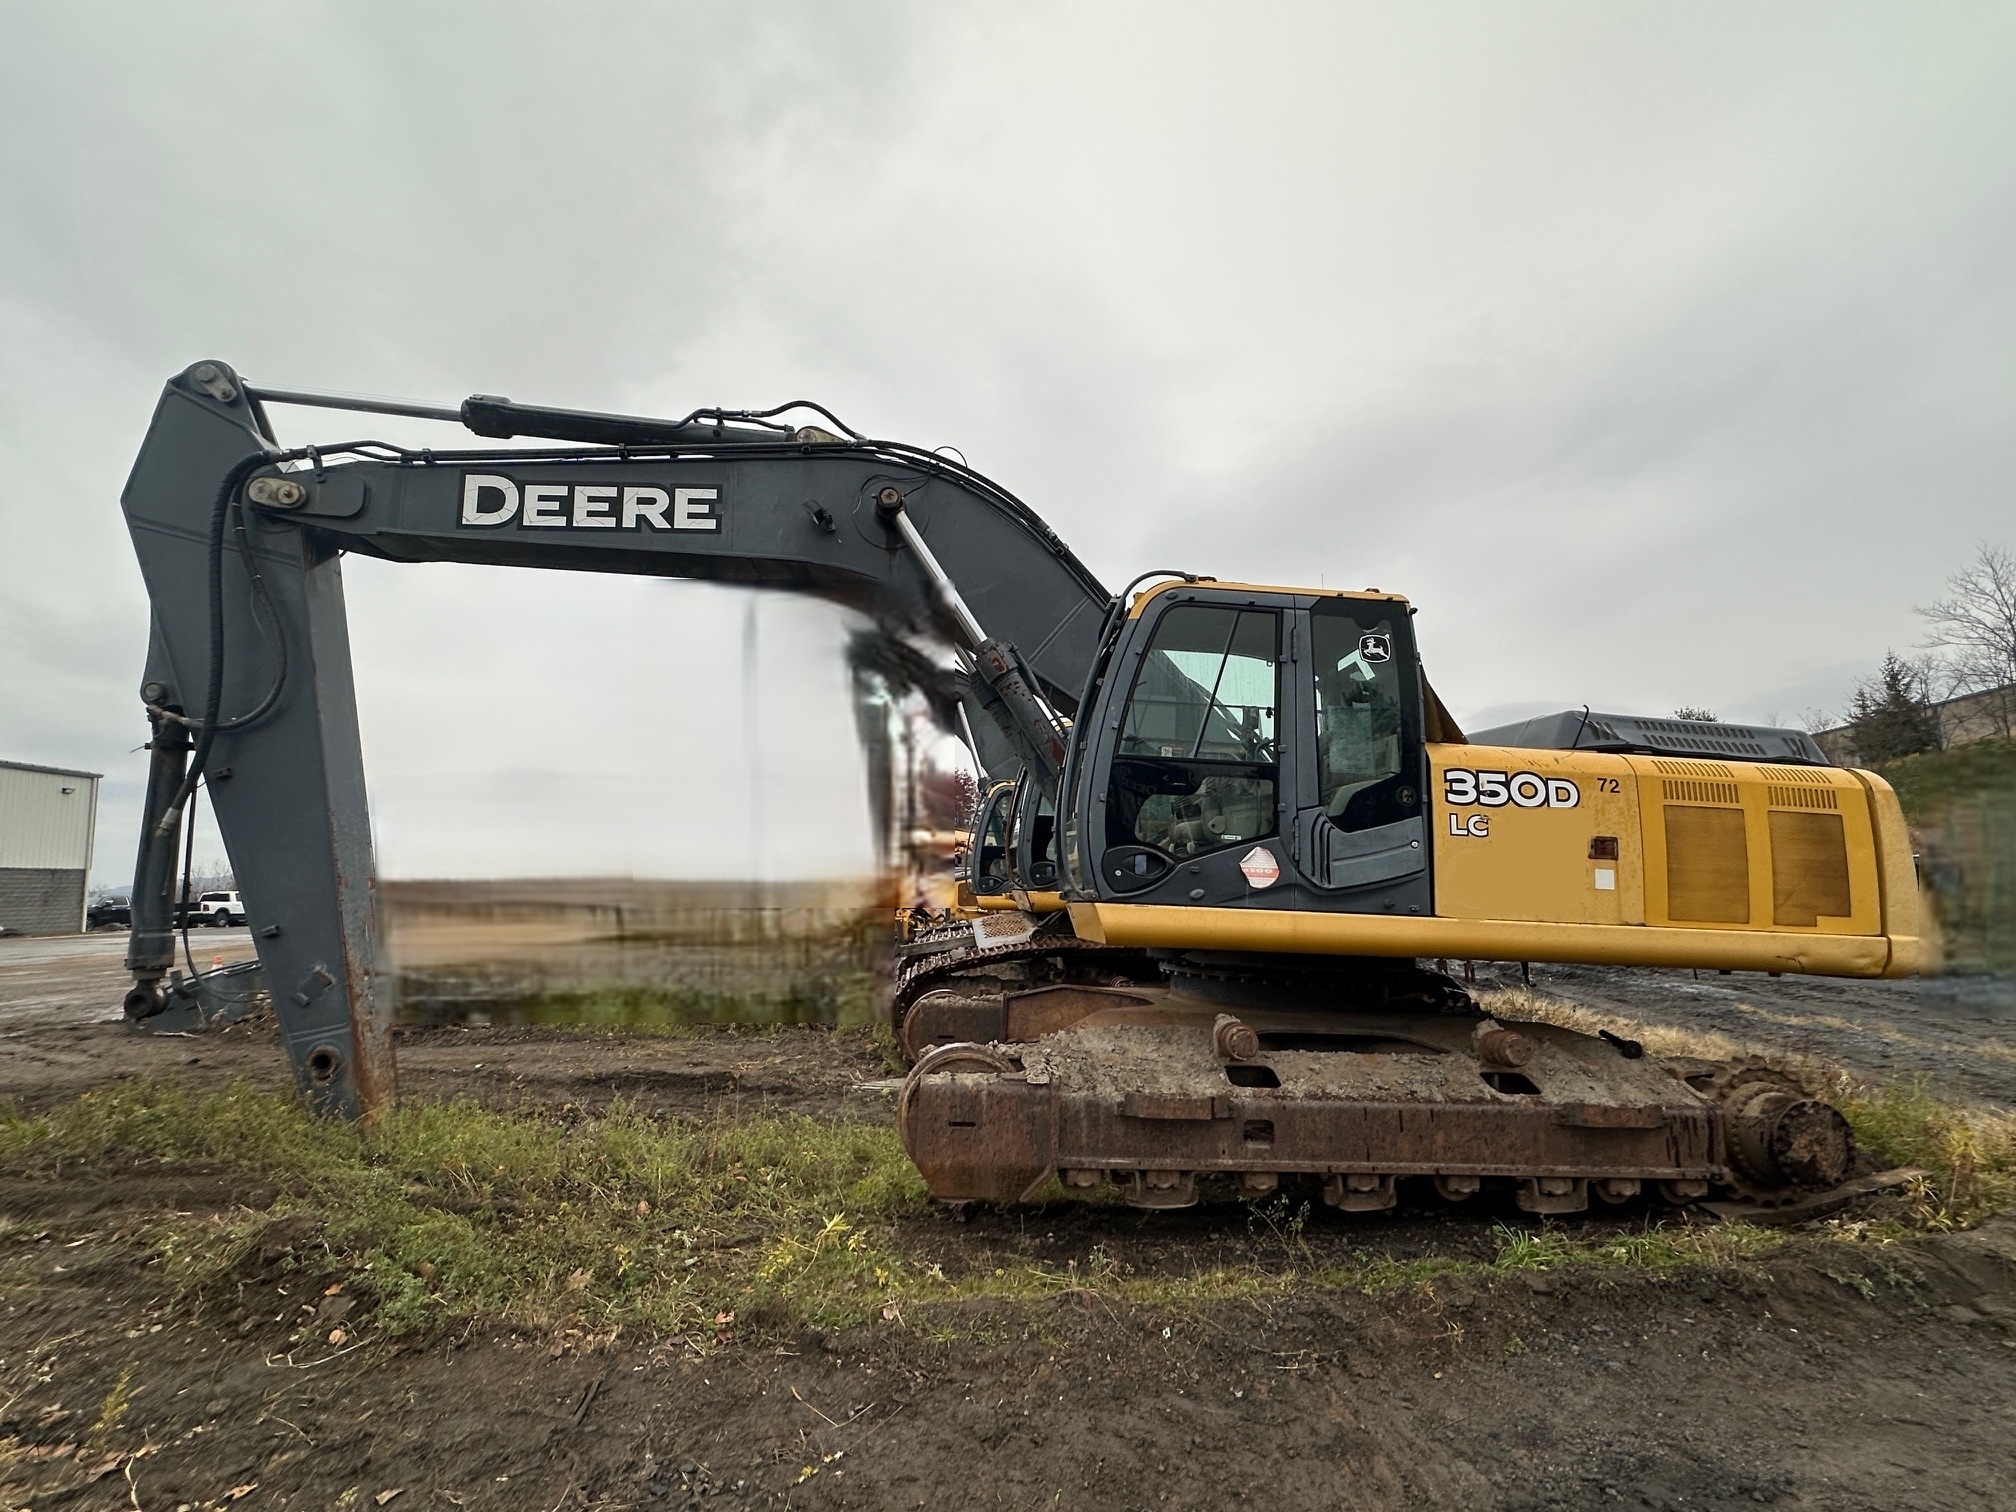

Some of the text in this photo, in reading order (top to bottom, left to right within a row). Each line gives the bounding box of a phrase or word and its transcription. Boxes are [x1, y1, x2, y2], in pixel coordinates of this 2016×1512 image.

[460, 473, 719, 531] DEERE
[1444, 769, 1580, 808] 350D
[1597, 777, 1620, 793] 72
[1449, 813, 1489, 837] LC
